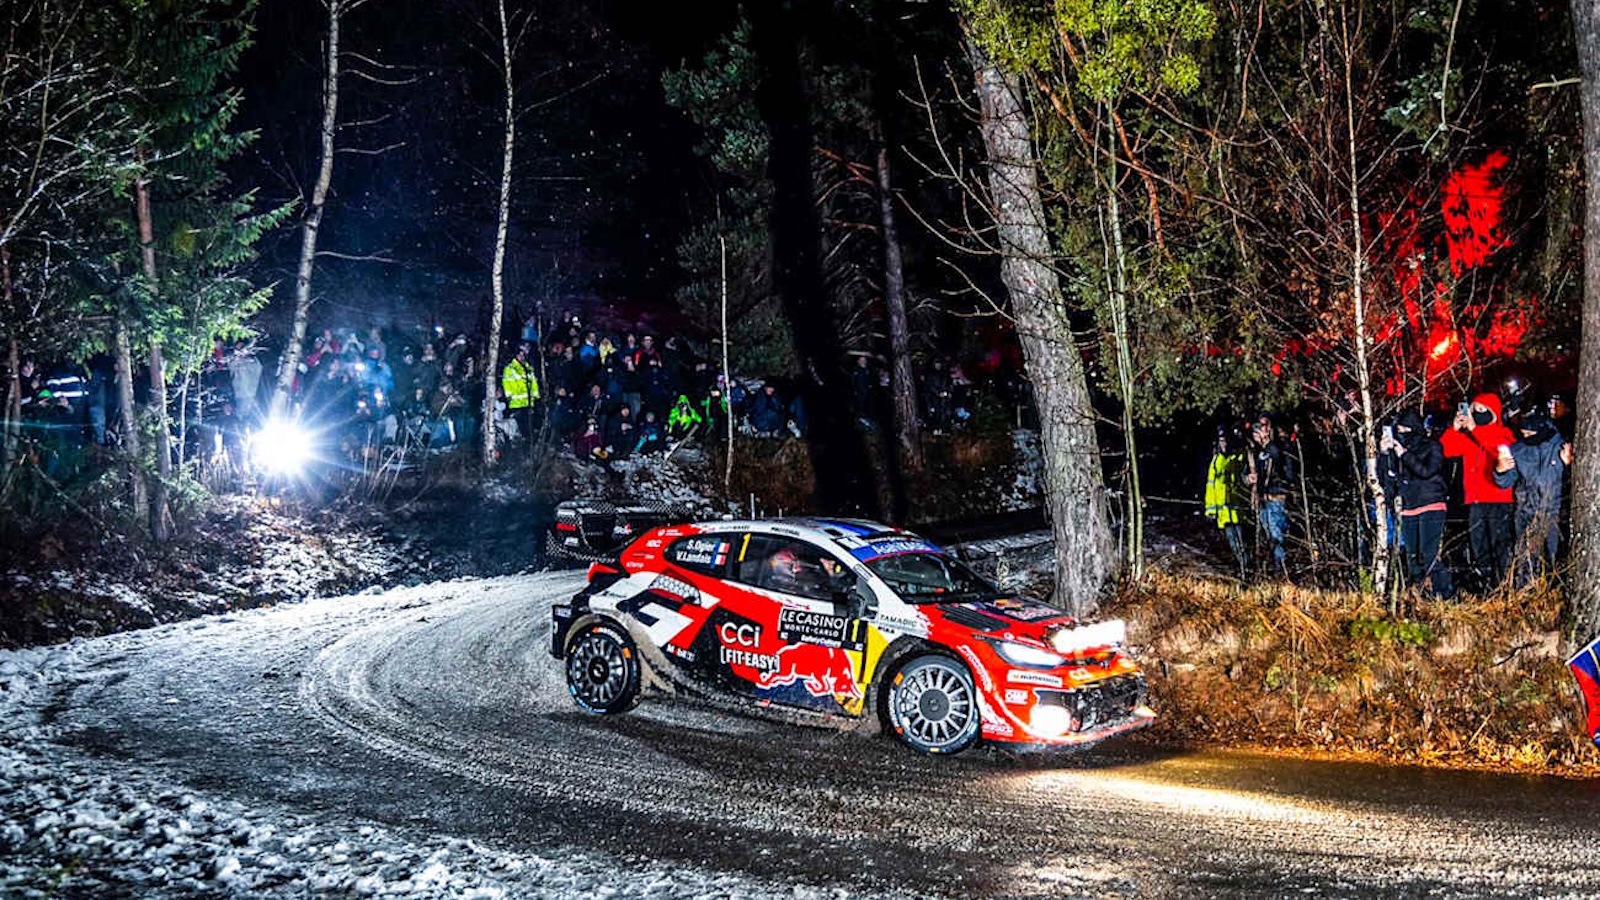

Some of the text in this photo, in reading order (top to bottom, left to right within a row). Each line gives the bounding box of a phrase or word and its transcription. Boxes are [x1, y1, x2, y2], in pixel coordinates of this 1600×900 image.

[686, 539, 715, 552] S.Ogier
[738, 532, 751, 562] 1
[782, 610, 844, 630] LE CASINO
[852, 618, 860, 643] 1
